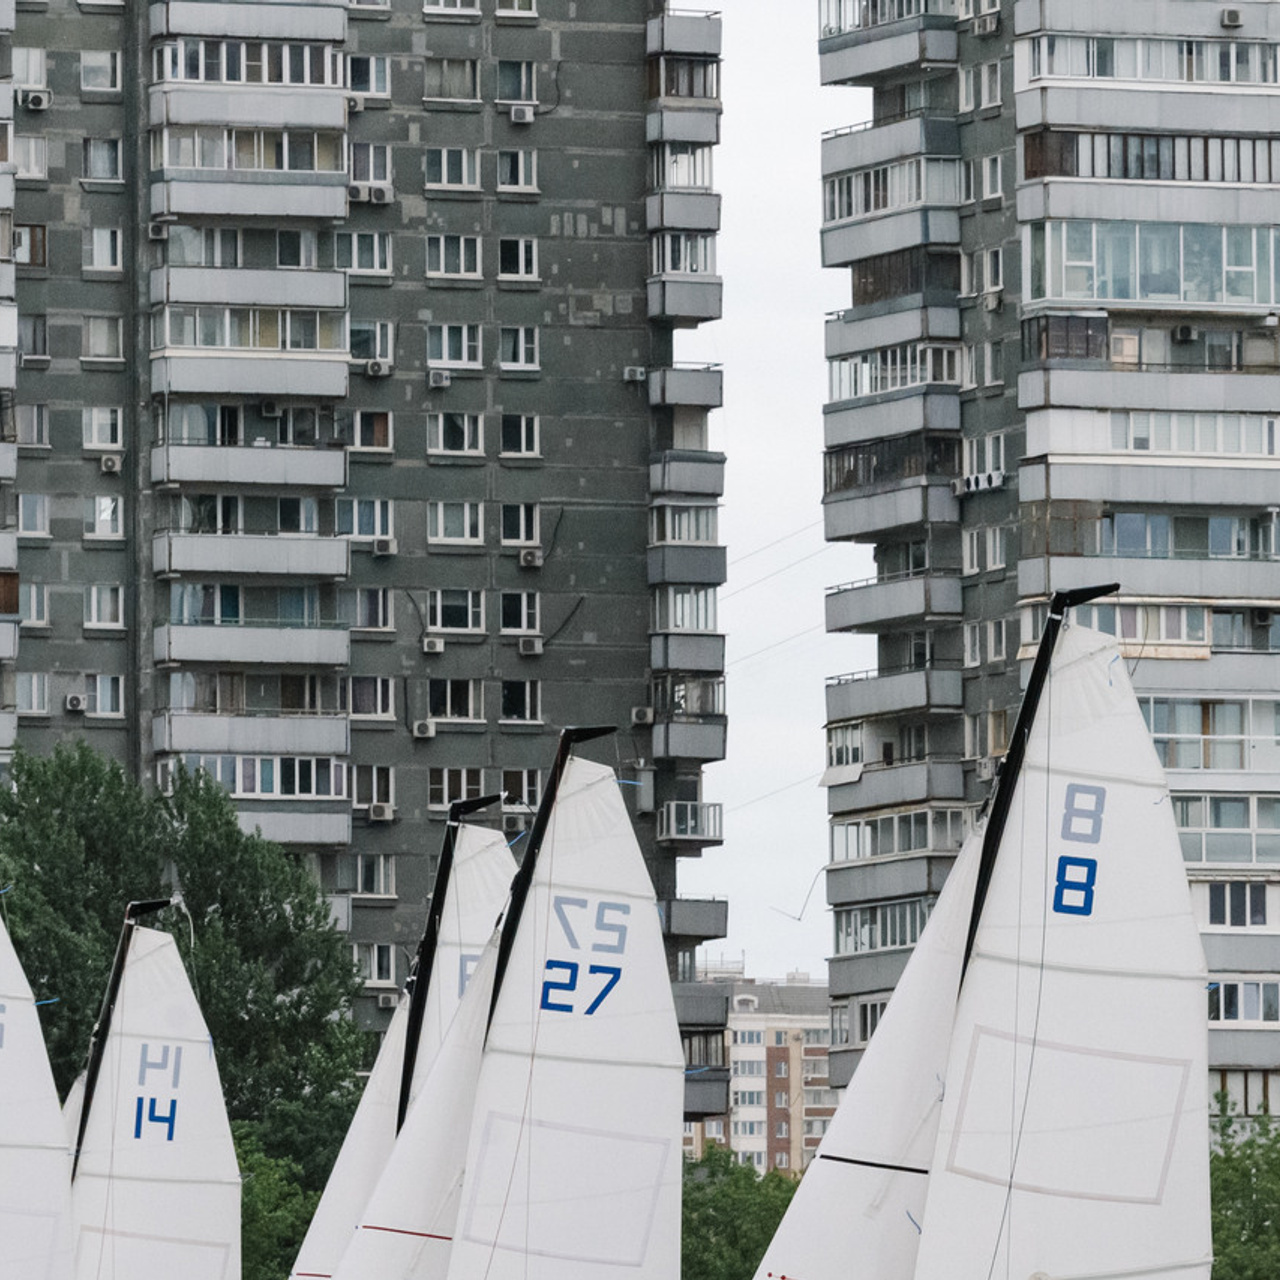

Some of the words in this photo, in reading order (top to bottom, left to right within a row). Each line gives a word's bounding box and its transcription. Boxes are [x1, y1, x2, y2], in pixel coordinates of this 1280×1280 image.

[1053, 855, 1097, 916] 8
[540, 959, 622, 1015] 27
[134, 1096, 177, 1141] 14
